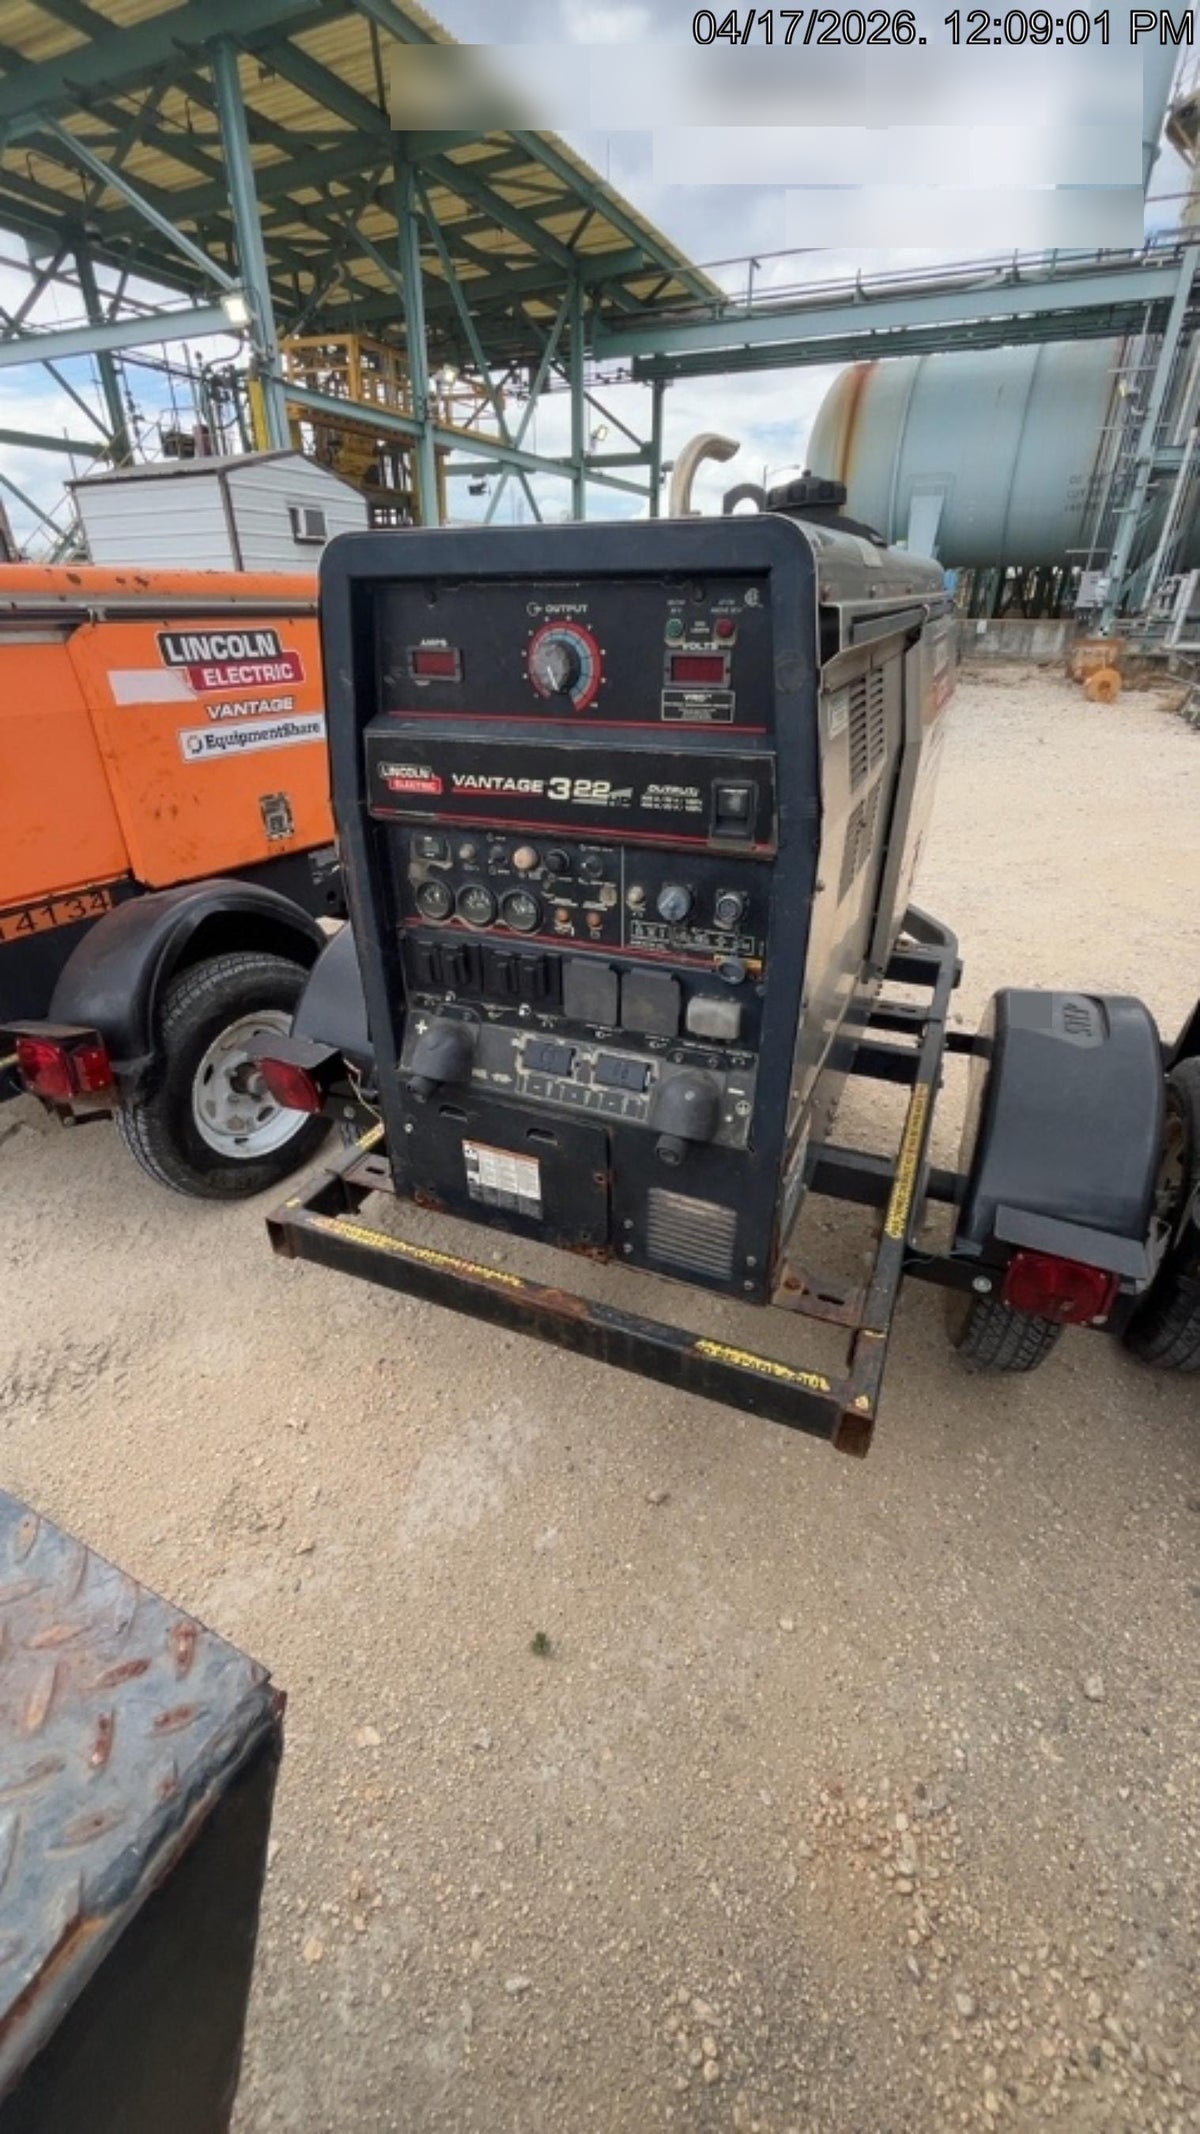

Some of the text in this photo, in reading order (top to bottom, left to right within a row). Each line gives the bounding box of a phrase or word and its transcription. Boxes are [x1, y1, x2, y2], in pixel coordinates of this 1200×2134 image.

[545, 604, 588, 613] OUTPUT
[165, 633, 277, 662] LINCOLN
[203, 663, 294, 686] ELECTRIC
[207, 697, 293, 719] VANTAGE
[205, 722, 320, 749] EquipmentShare
[452, 773, 545, 793] VANTAGE
[547, 777, 611, 800] 322
